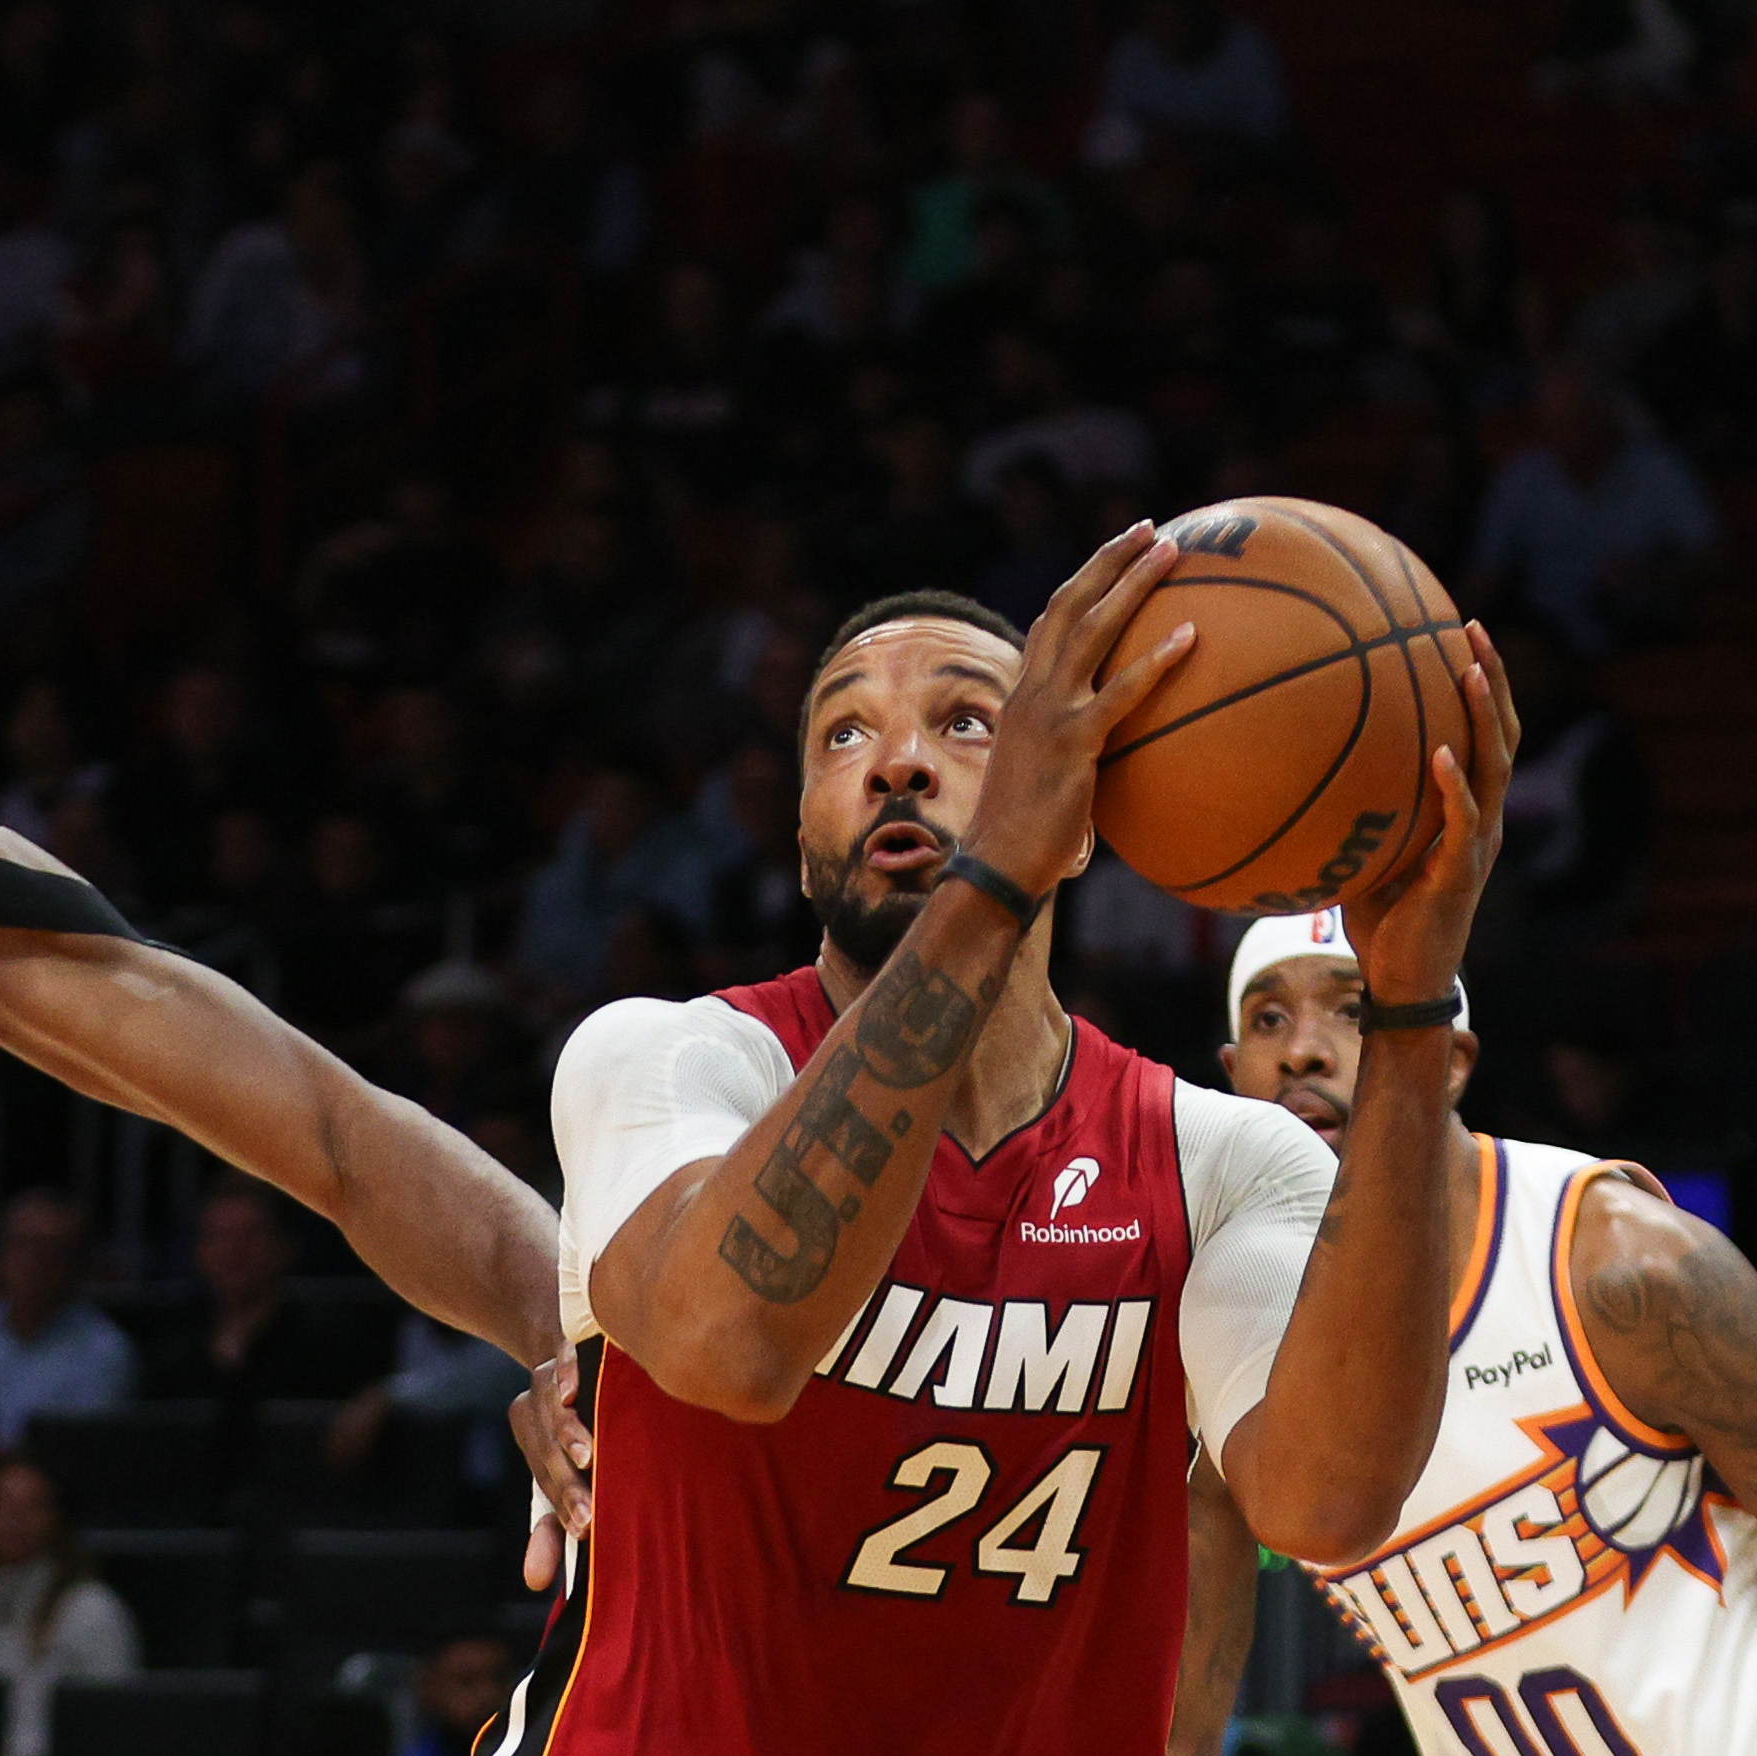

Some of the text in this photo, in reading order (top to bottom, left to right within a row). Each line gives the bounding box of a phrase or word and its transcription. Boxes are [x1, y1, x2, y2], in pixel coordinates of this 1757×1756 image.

[1019, 1217, 1142, 1245] Robinhood
[1463, 1340, 1554, 1392] PayPal
[841, 1438, 1106, 1607] 24
[1332, 1482, 1586, 1674] UNS
